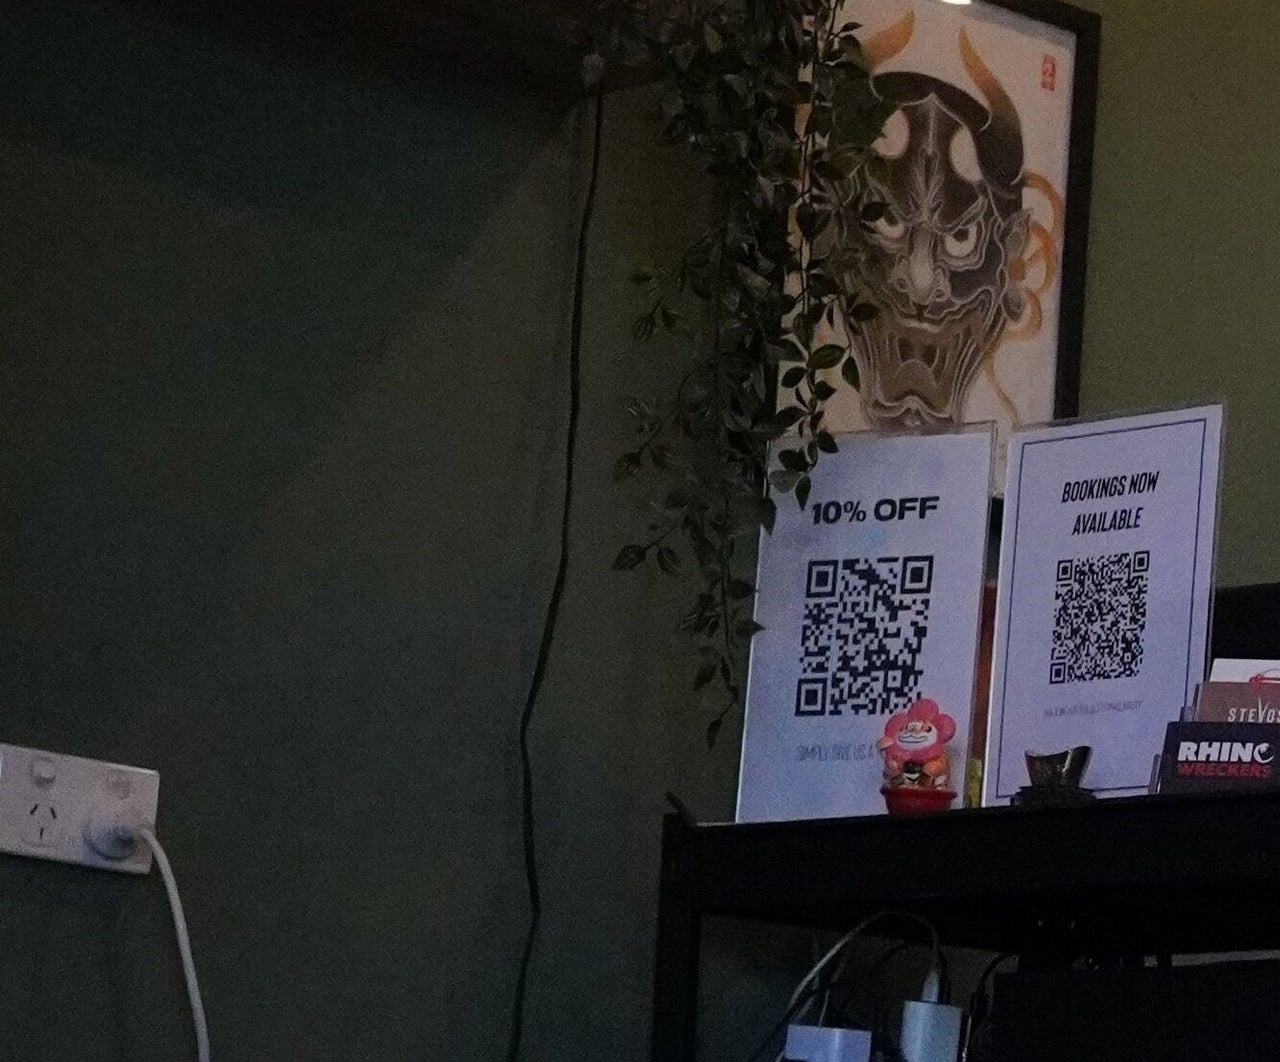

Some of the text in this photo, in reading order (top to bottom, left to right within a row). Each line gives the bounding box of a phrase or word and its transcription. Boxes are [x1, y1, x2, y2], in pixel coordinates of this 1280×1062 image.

[1062, 471, 1160, 503] BOOKINGS NOW
[811, 496, 940, 525] 10% OFF
[1071, 507, 1144, 536] AVAILABLE
